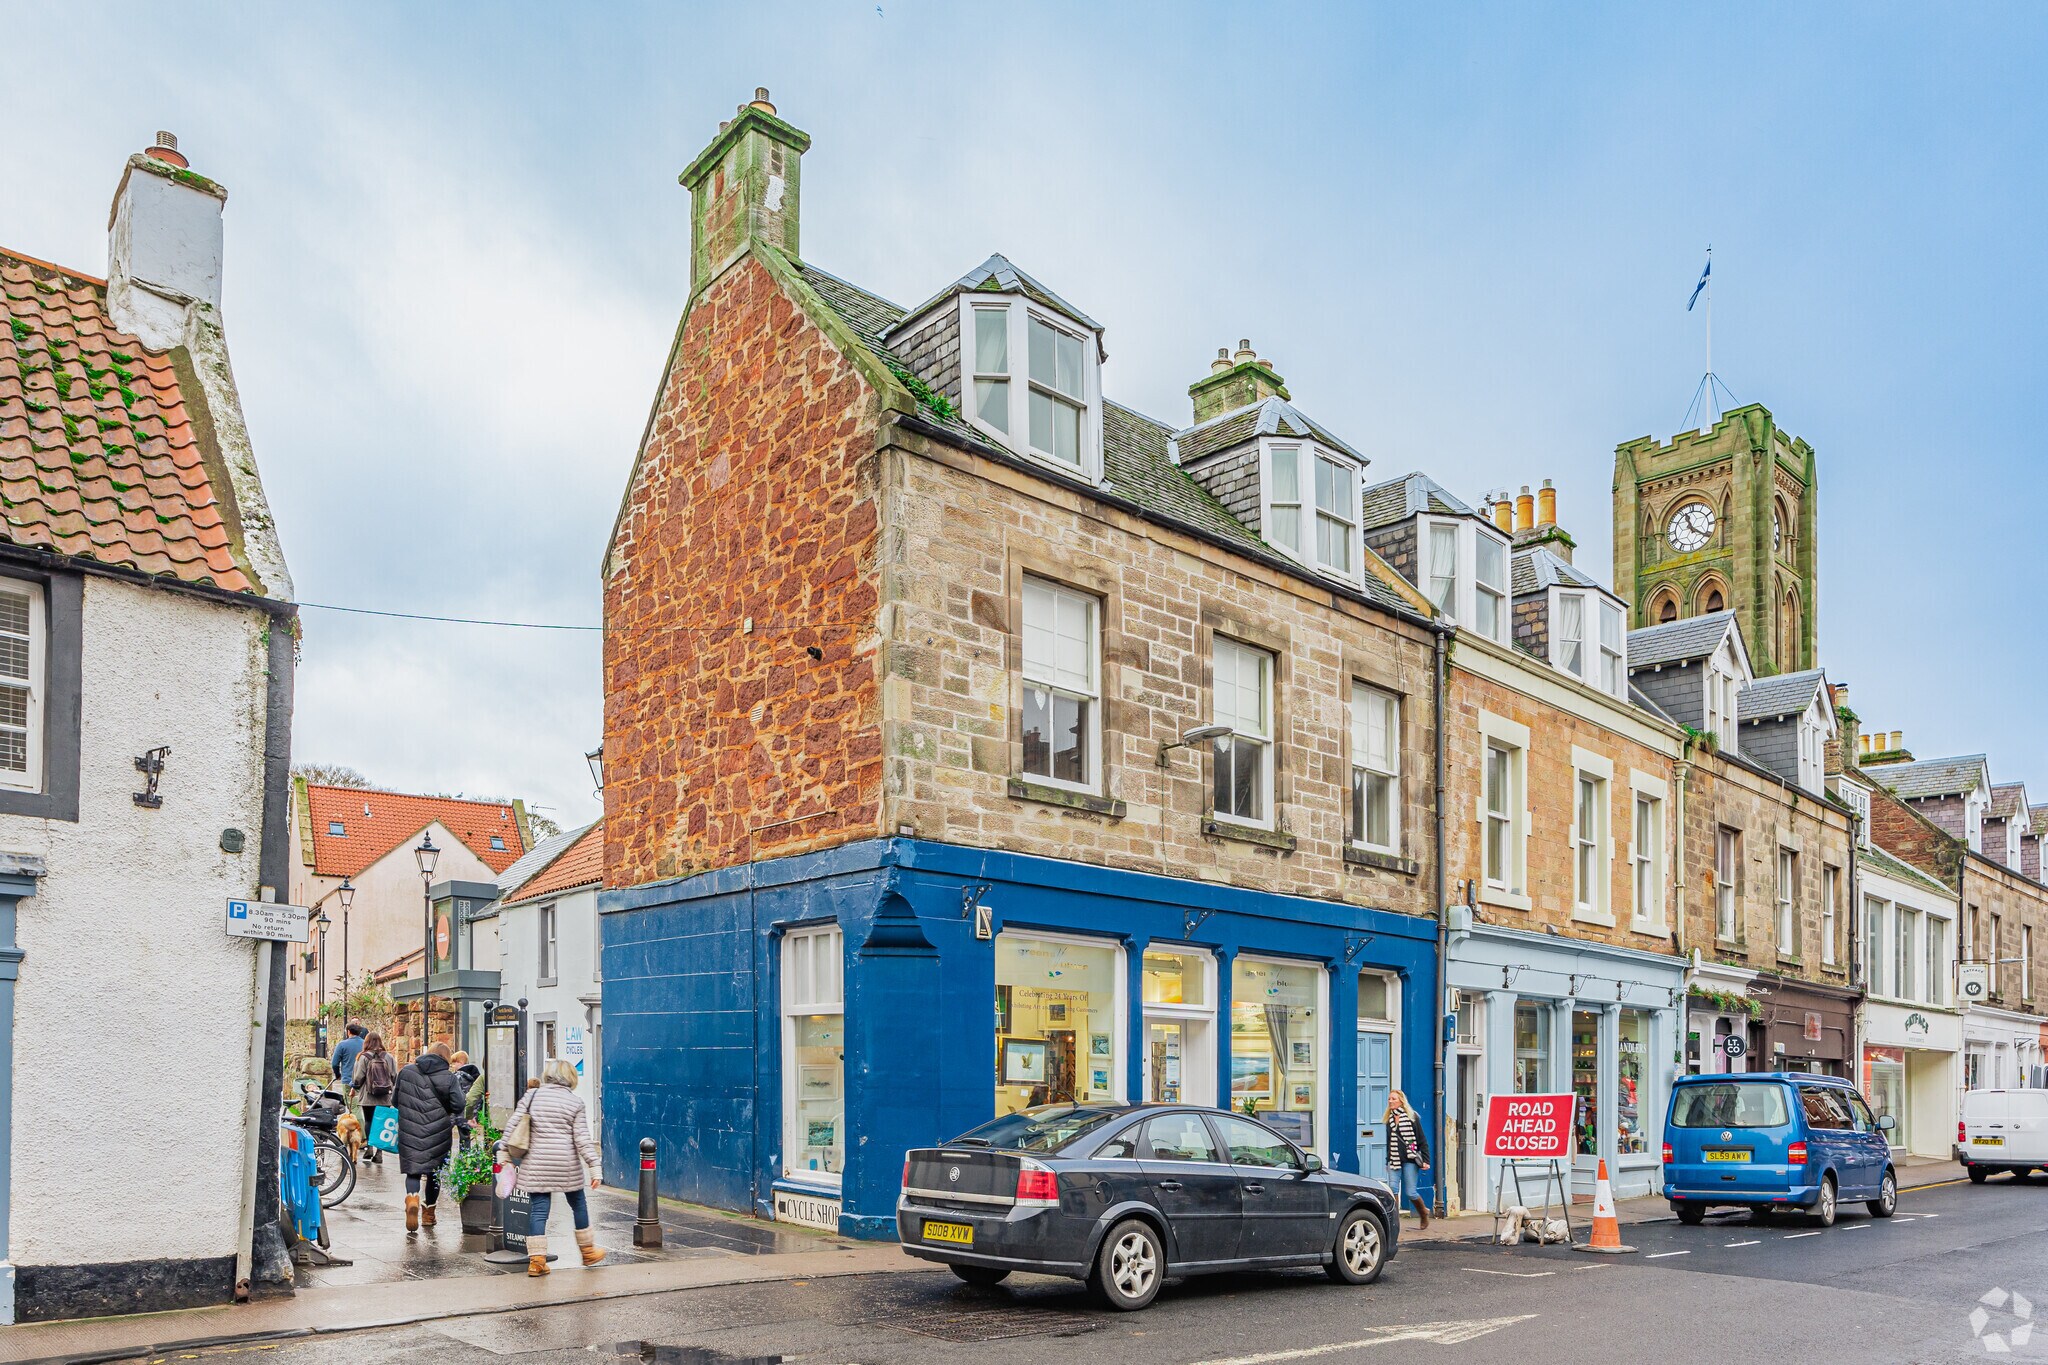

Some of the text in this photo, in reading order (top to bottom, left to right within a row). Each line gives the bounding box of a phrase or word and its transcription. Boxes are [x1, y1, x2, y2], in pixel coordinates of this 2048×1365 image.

[248, 909, 274, 917] 8.30am
[1019, 990, 1053, 1001] Celebrating
[1063, 992, 1078, 1000] Years
[1905, 1012, 1929, 1034] FATFACE
[565, 1027, 583, 1041] LAW
[566, 1046, 583, 1054] CYCLES
[1508, 1102, 1554, 1116] ROAD
[1502, 1119, 1556, 1133] AHEAD
[1495, 1135, 1559, 1150] CLOSED
[1709, 1152, 1730, 1160] SL59
[787, 1198, 840, 1226] CYCLE SHOP
[927, 1223, 970, 1240] SD08 XVW
